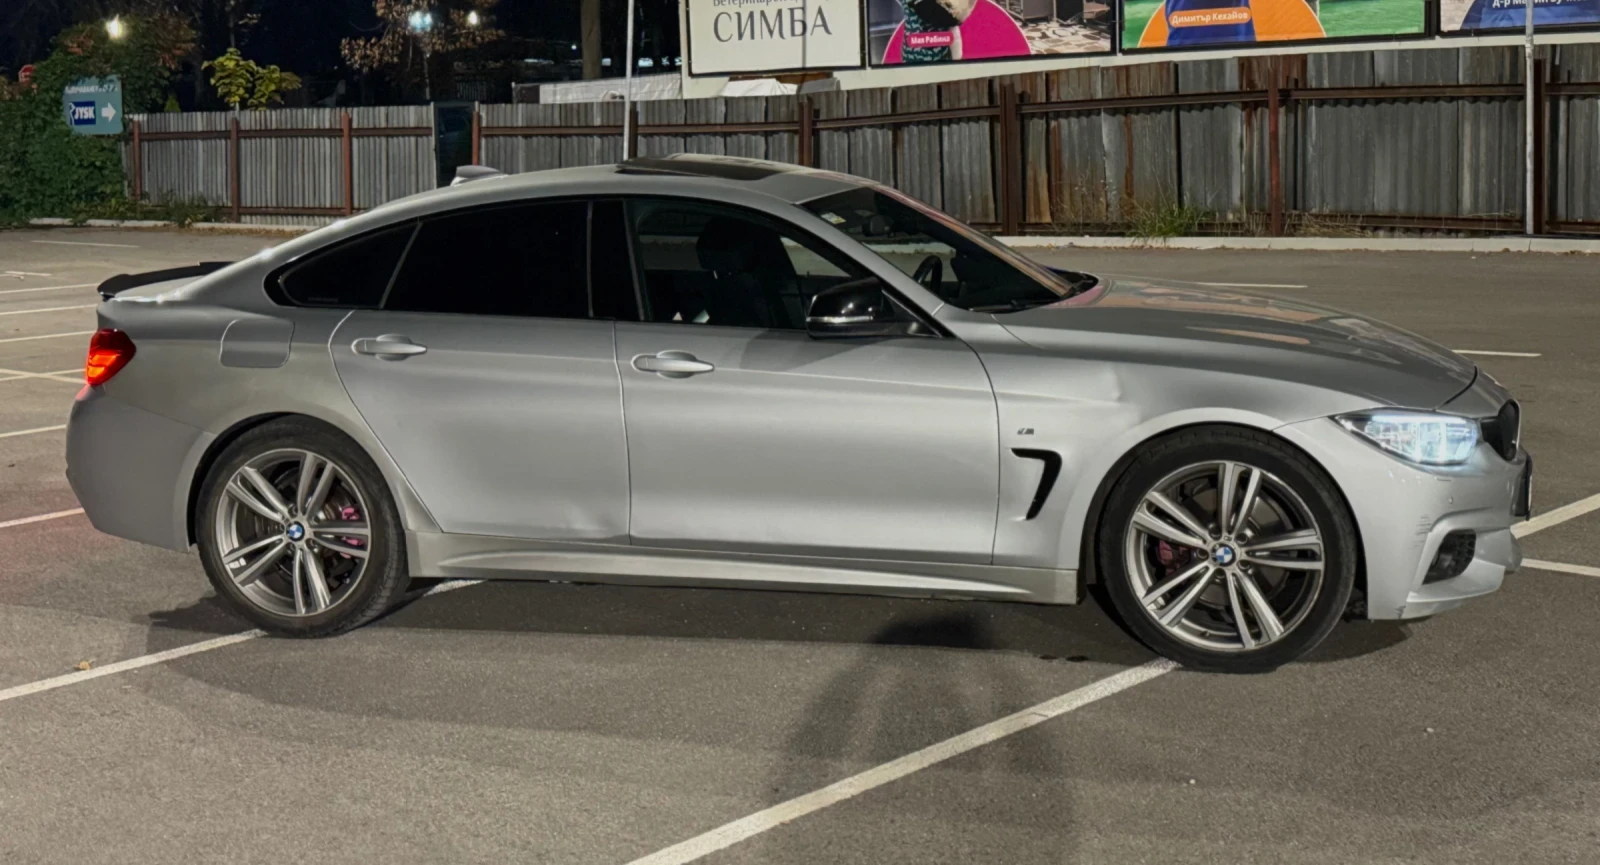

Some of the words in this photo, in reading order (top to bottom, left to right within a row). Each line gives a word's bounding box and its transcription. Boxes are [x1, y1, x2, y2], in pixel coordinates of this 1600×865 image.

[713, 5, 833, 43] СИМБА
[1172, 15, 1211, 25] Димитър
[1212, 11, 1249, 20] Кехайов
[74, 106, 95, 120] JYSK
